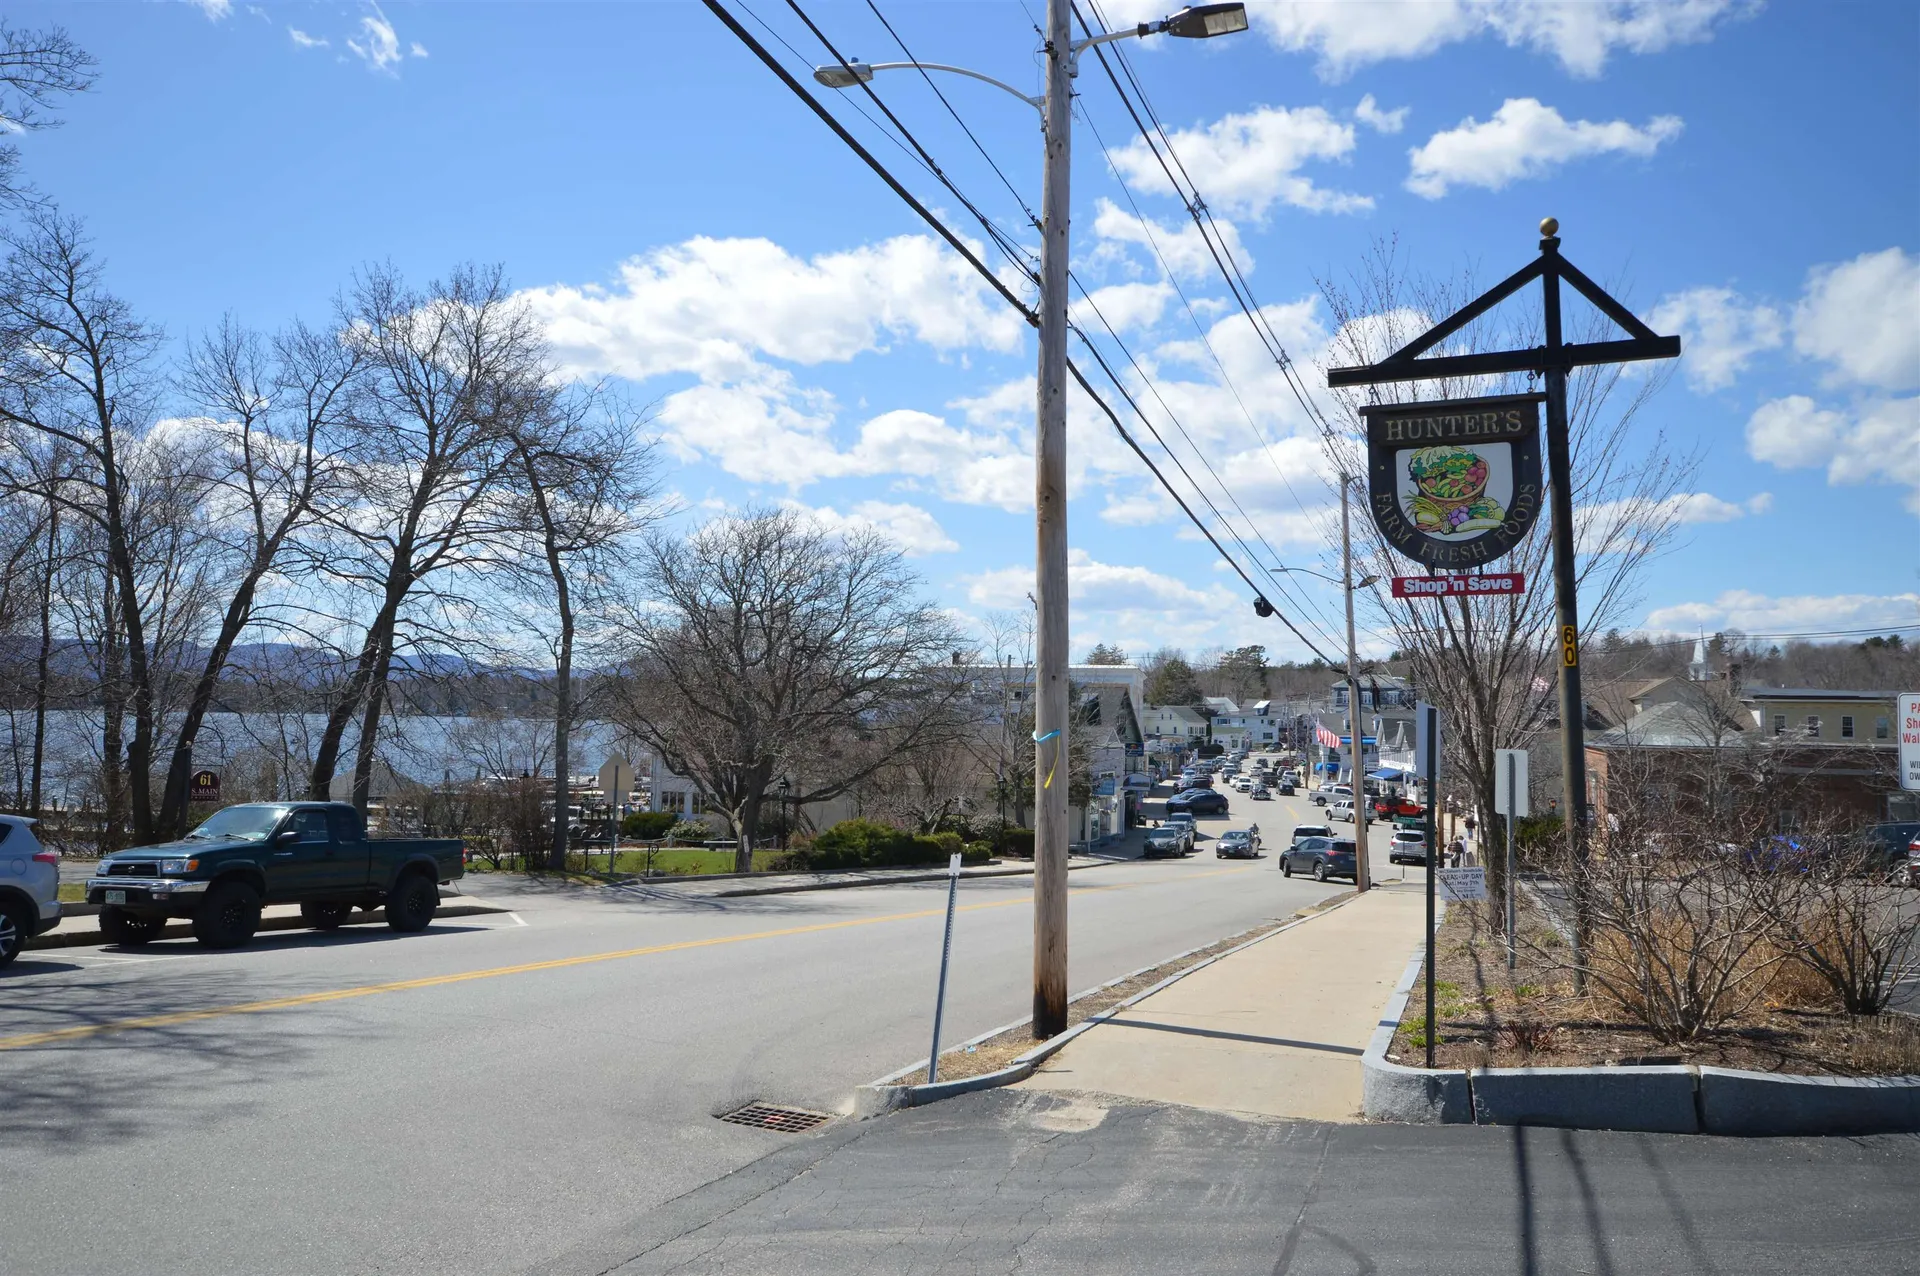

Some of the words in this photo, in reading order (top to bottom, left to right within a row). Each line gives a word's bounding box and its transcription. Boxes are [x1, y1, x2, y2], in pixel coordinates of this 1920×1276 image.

[1385, 410, 1522, 441] HUNTER'S
[1375, 491, 1413, 545] FARM
[1418, 541, 1488, 563] FRESH
[1495, 483, 1536, 545] FOODS
[1467, 576, 1513, 590] Save
[200, 774, 211, 785] 61
[199, 787, 218, 795] MAIN
